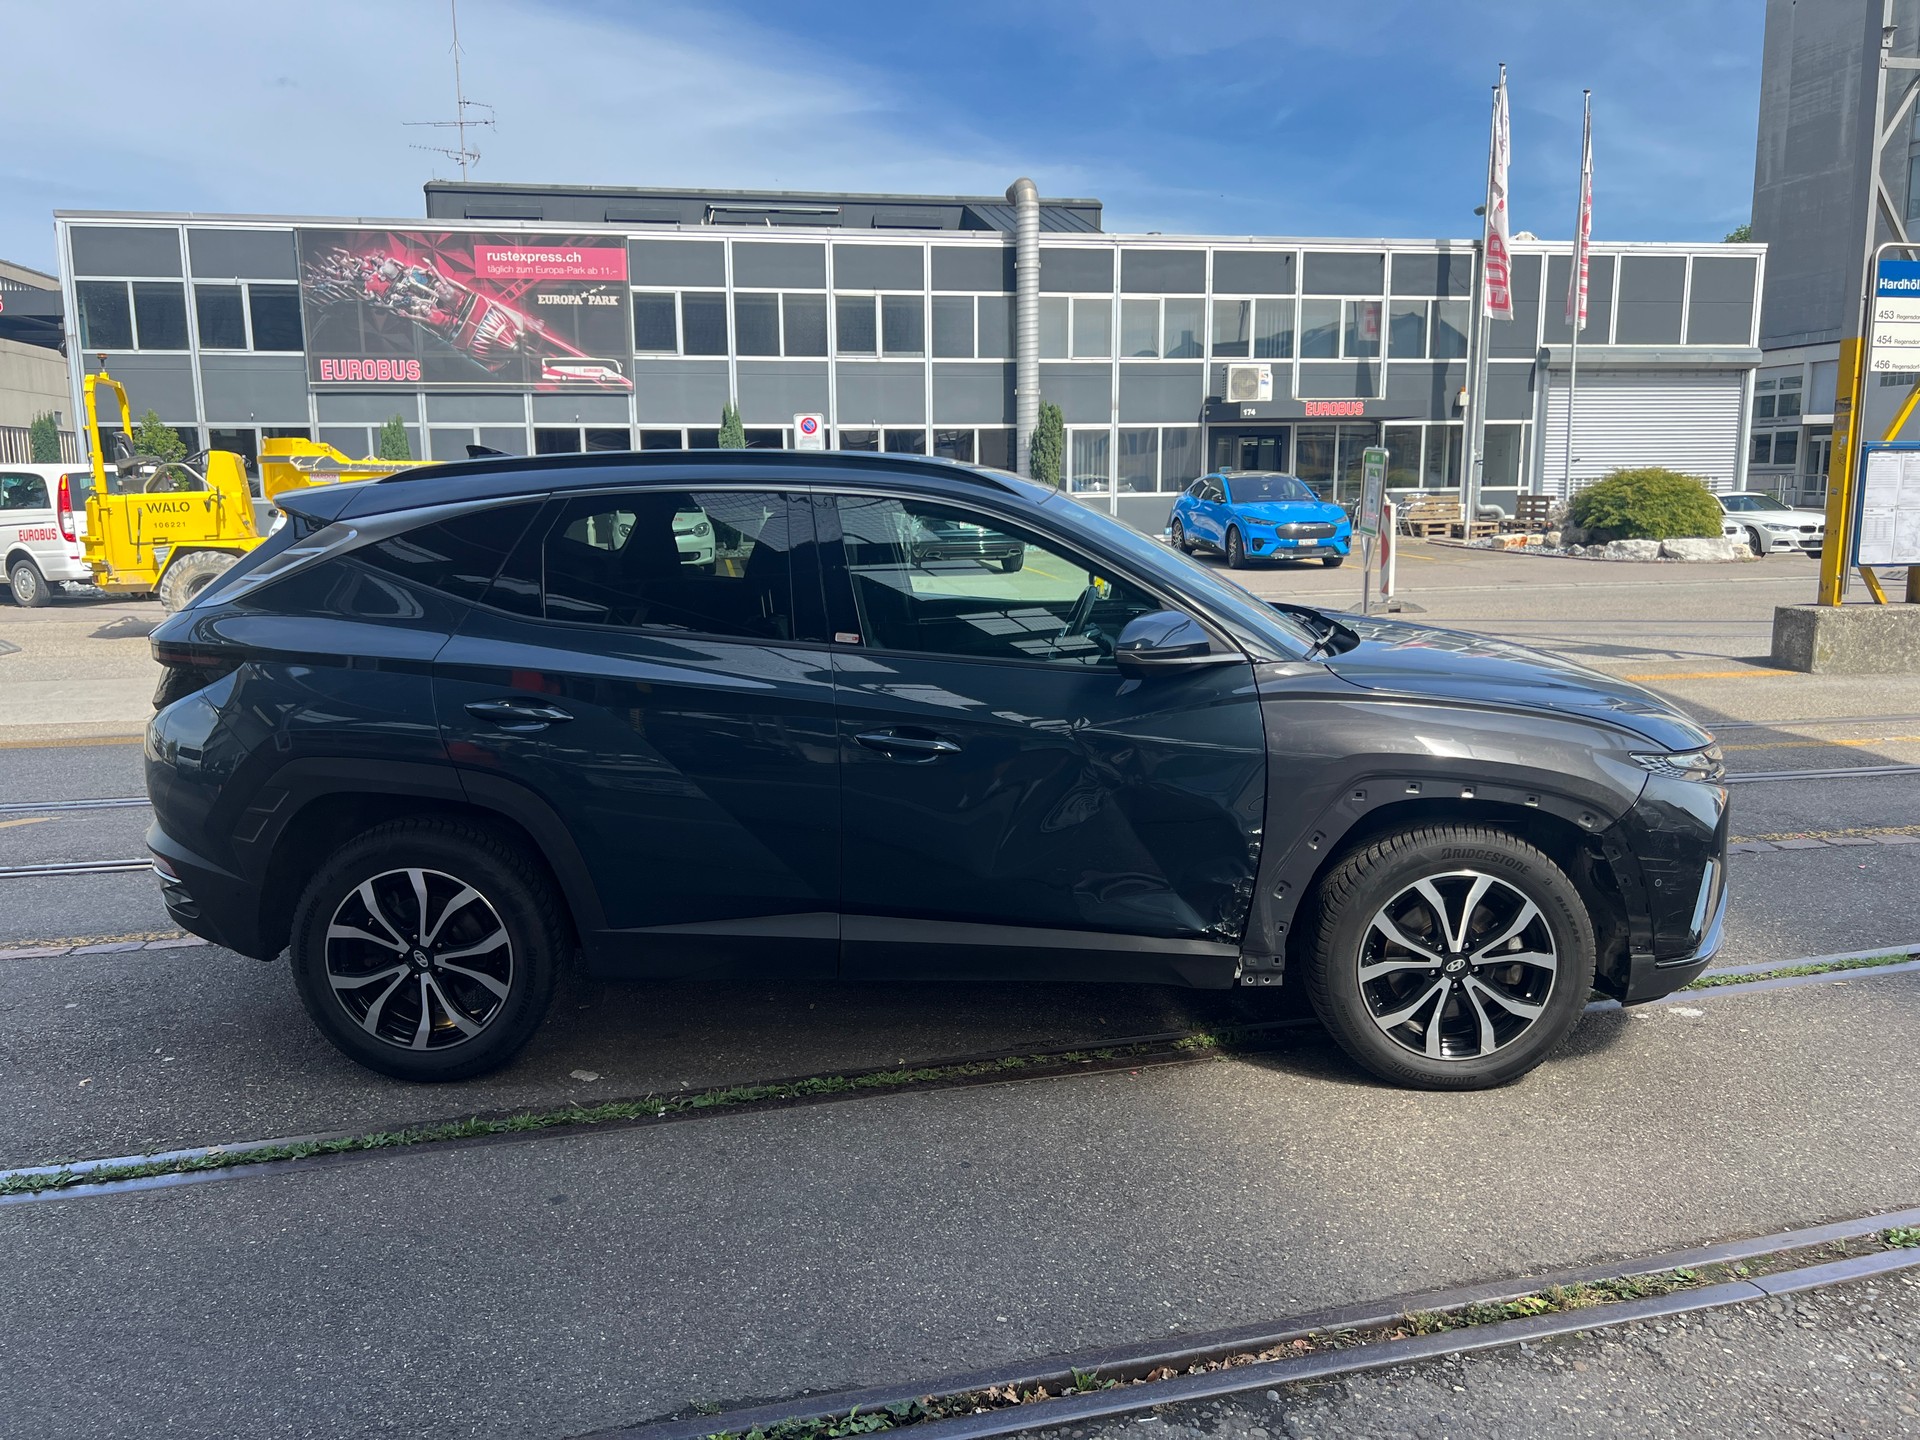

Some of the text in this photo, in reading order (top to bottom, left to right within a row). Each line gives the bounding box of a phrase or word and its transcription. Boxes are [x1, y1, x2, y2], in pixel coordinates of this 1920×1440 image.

[486, 251, 582, 264] rustexpress.ch
[487, 265, 514, 275] täglich
[535, 266, 585, 276] Europa-Park
[587, 267, 597, 275] ab
[537, 294, 619, 305] EUROPA PARK
[1878, 310, 1894, 320] 453
[1876, 335, 1892, 345] 454
[320, 359, 421, 381] EUROBUS
[1874, 360, 1890, 370] 456
[1243, 408, 1256, 416] 174
[1305, 401, 1364, 416] EUROBUS
[146, 501, 191, 513] WALO
[18, 528, 58, 542] EUROBUS
[1440, 848, 1532, 875] BRIDGESTONE
